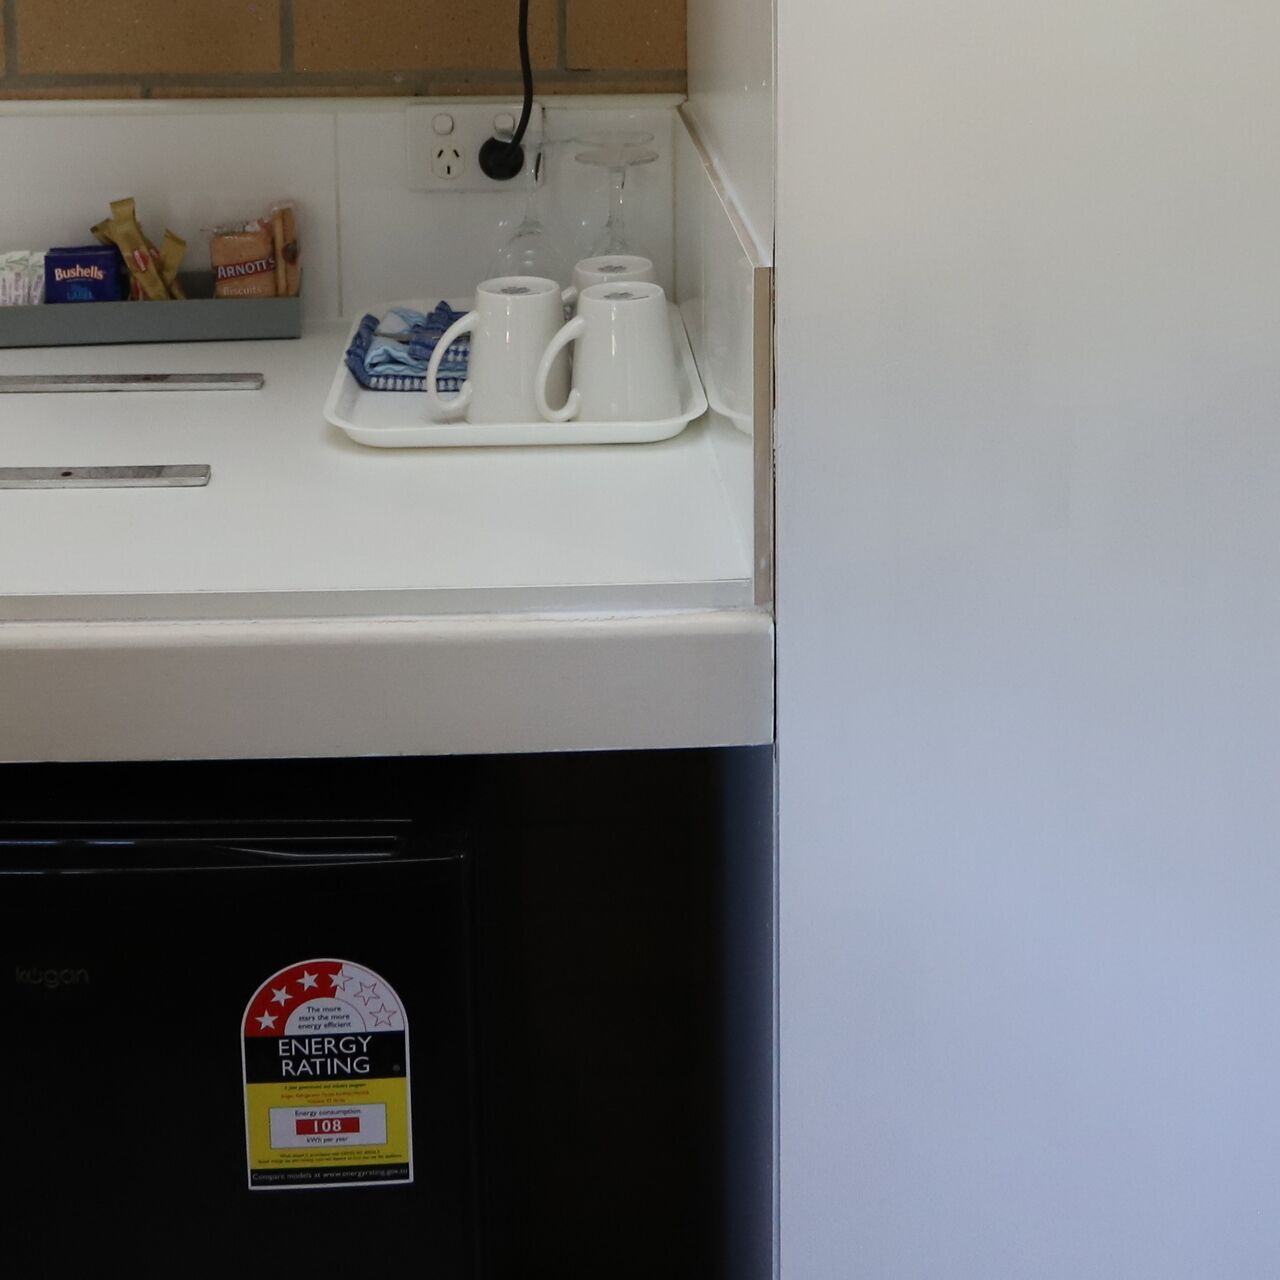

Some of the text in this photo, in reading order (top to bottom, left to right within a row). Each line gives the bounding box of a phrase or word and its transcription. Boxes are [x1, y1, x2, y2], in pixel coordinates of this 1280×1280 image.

[54, 264, 104, 281] Bushells
[223, 285, 262, 297] Biscuits
[297, 1023, 321, 1031] energy
[278, 1035, 372, 1057] ENERGY
[282, 1056, 370, 1077] RATING
[294, 1108, 361, 1119] Energy consumption
[313, 1119, 342, 1133] 108
[323, 1136, 334, 1145] per
[335, 1135, 349, 1143] year
[252, 1173, 285, 1182] Compare
[286, 1172, 312, 1180] models
